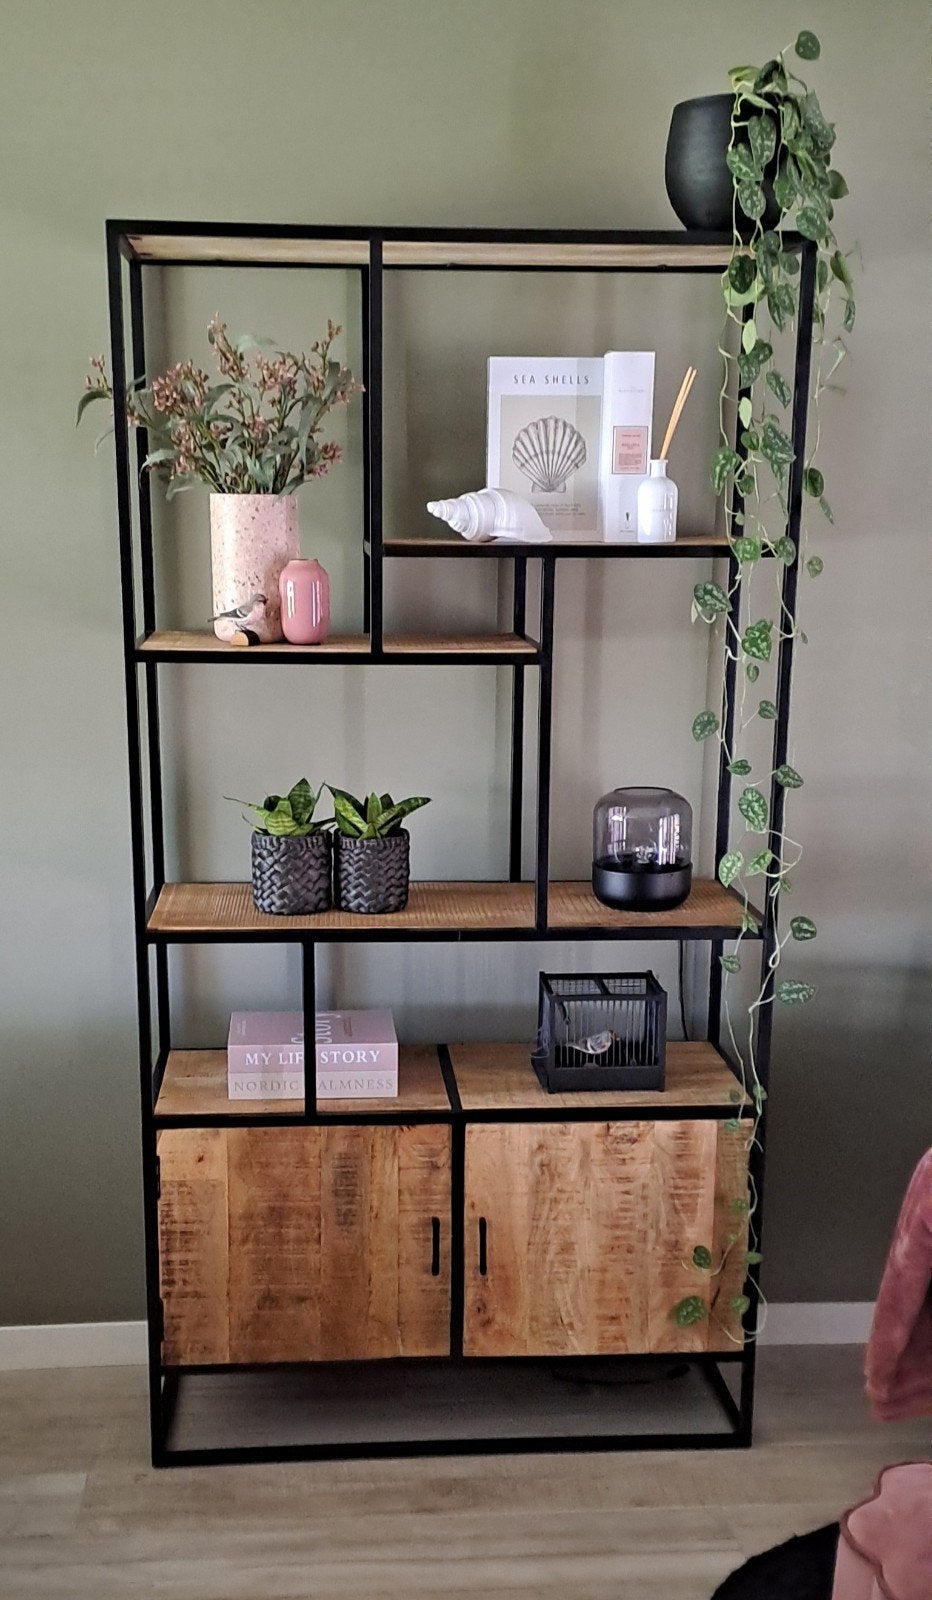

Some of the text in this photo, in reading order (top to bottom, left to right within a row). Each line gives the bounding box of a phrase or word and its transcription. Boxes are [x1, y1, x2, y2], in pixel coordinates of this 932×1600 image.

[513, 373, 590, 385] SEA SHELLS
[245, 1050, 380, 1066] MY LIF STORY
[234, 1078, 394, 1093] NORDIC ALMNESS
